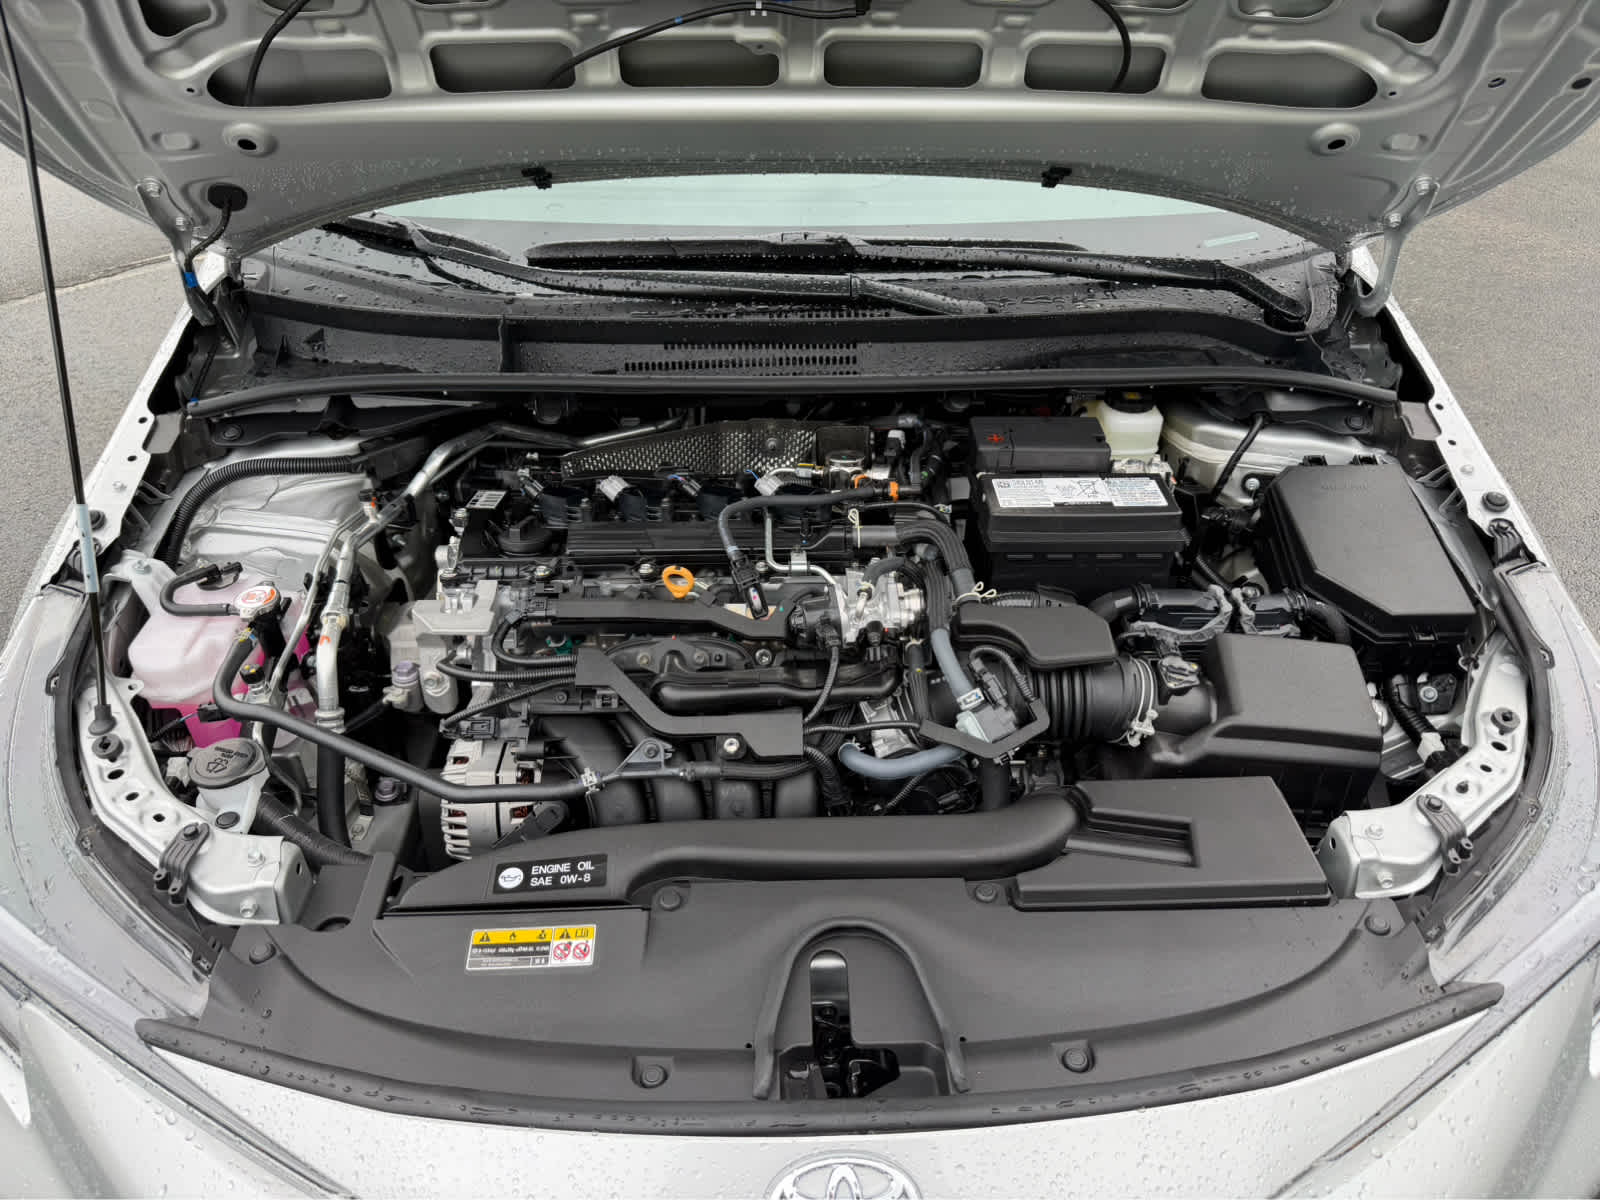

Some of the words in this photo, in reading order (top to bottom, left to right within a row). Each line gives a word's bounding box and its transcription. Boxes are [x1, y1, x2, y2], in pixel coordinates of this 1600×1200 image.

[531, 862, 571, 875] ENGINE
[577, 860, 595, 871] OIL
[530, 876, 553, 887] SAE
[560, 873, 591, 885] 0W-8
